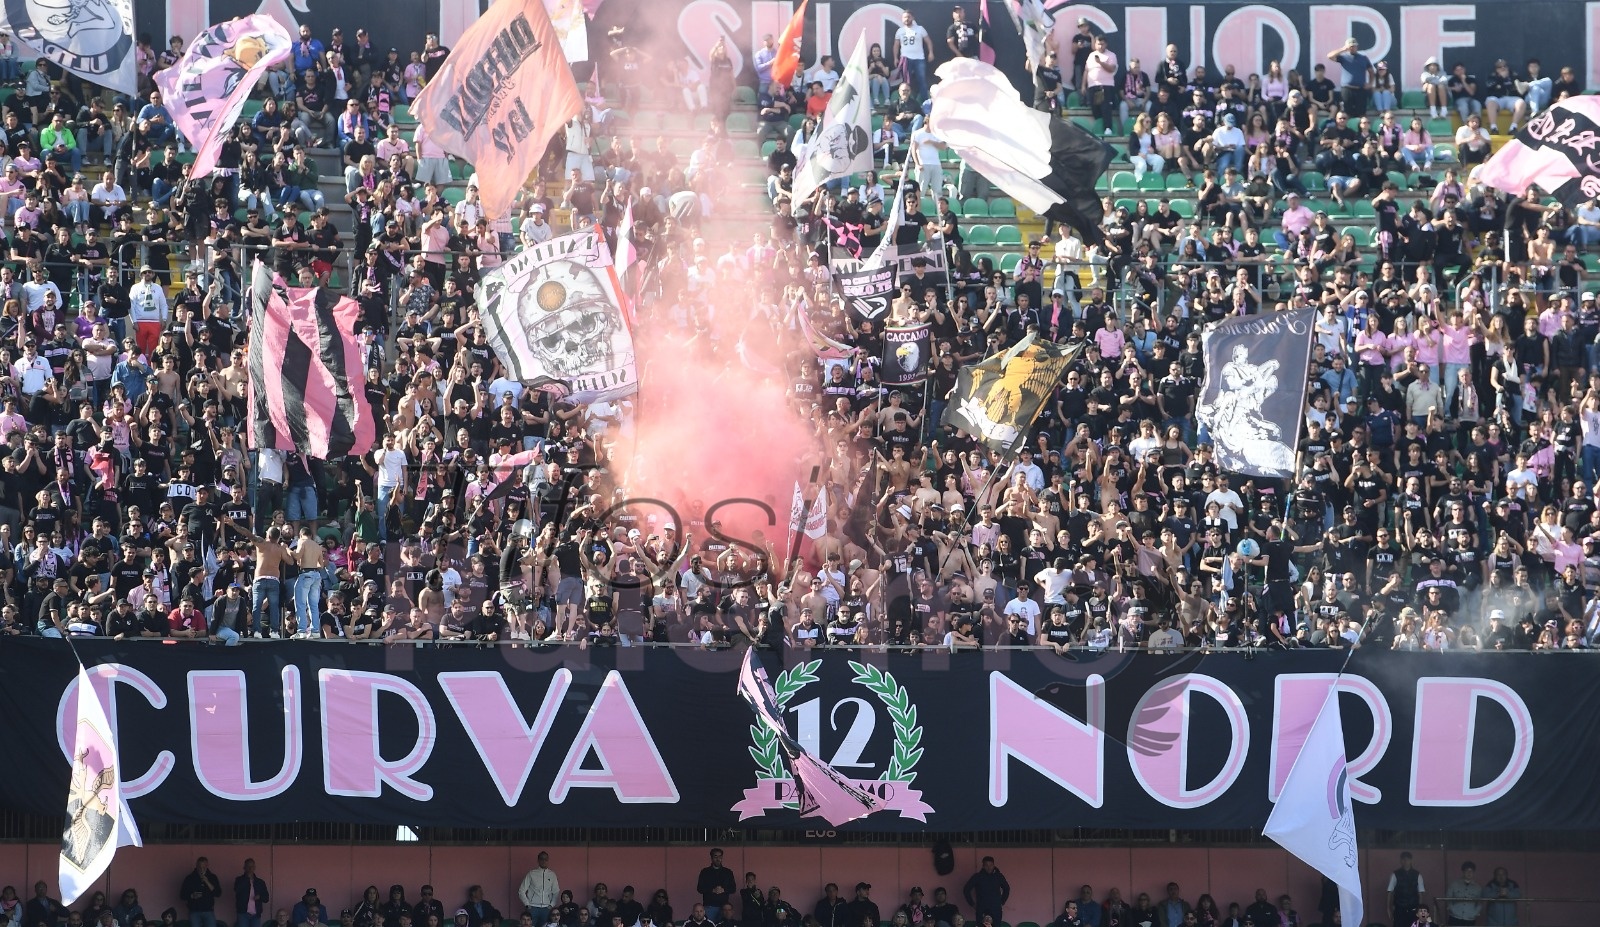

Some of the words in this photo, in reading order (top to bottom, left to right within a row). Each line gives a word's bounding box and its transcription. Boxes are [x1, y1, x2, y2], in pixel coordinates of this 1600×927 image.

[903, 36, 915, 45] 28
[871, 271, 891, 282] AMO
[878, 280, 892, 292] TE
[886, 328, 929, 342] CACCAMO
[228, 511, 238, 519] LA
[55, 662, 681, 807] CURVA
[988, 668, 1534, 809] NORD
[788, 696, 877, 768] 12
[774, 782, 895, 802] PAMO
